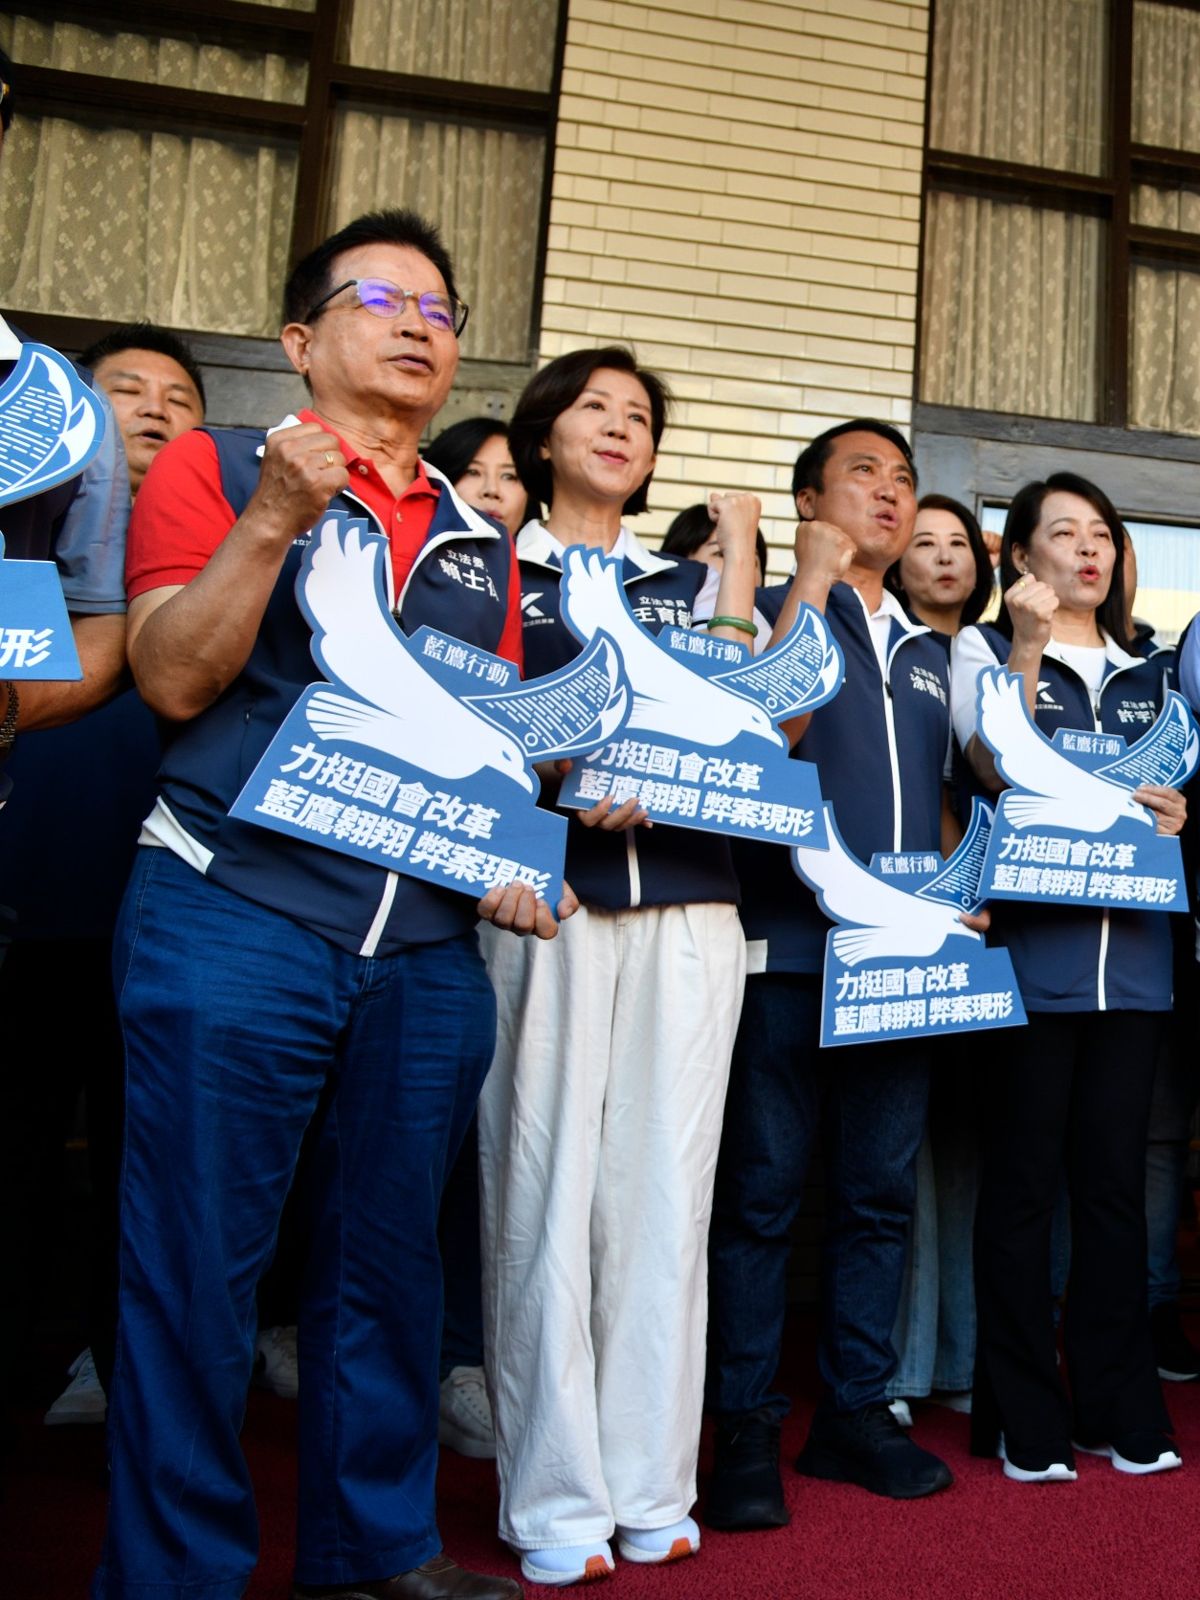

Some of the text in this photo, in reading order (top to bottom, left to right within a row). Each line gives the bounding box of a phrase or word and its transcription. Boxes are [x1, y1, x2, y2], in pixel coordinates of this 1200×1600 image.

[447, 549, 488, 572] 立法委
[421, 634, 510, 688] 藍鷹行動
[670, 630, 742, 664] 藍鷹行動
[1062, 733, 1121, 756] 藍鷹行動
[585, 738, 764, 793] 力挺國會改革
[280, 741, 502, 841] 力挺國會改革
[701, 789, 815, 837] 弊案現形
[408, 829, 552, 899] 弊案現形
[879, 855, 938, 874] 藍鷹行動
[998, 833, 1137, 870] 力挺國會改革
[1088, 872, 1178, 904] 弊案現形
[835, 962, 969, 1001] 力挺國會改革
[928, 991, 1013, 1026] 弊案現形
